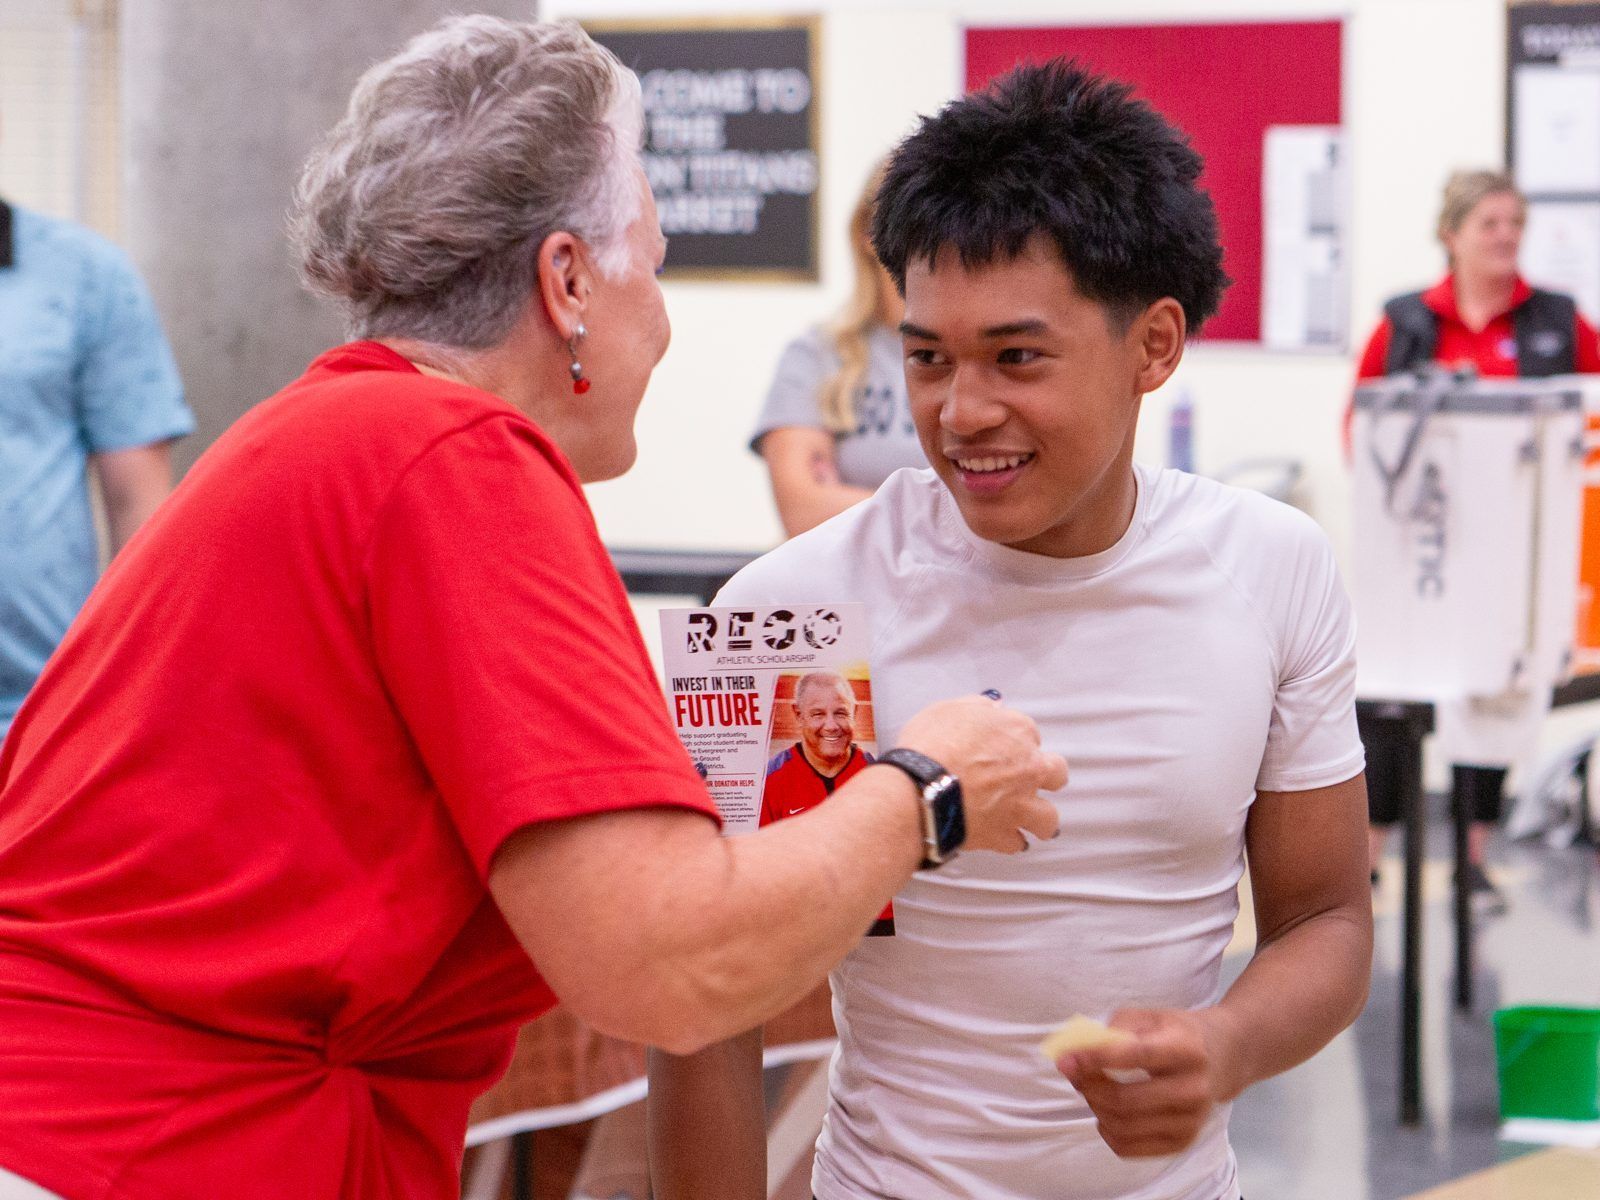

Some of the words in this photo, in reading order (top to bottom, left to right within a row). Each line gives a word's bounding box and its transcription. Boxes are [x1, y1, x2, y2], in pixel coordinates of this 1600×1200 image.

[755, 68, 811, 112] TO
[716, 656, 753, 665] ATHLETIC
[757, 654, 816, 664] SCHOLARSHIP
[672, 677, 708, 692] INVEST
[711, 676, 723, 690] IN
[725, 676, 756, 690] THEIR
[674, 692, 762, 728] FUTURE
